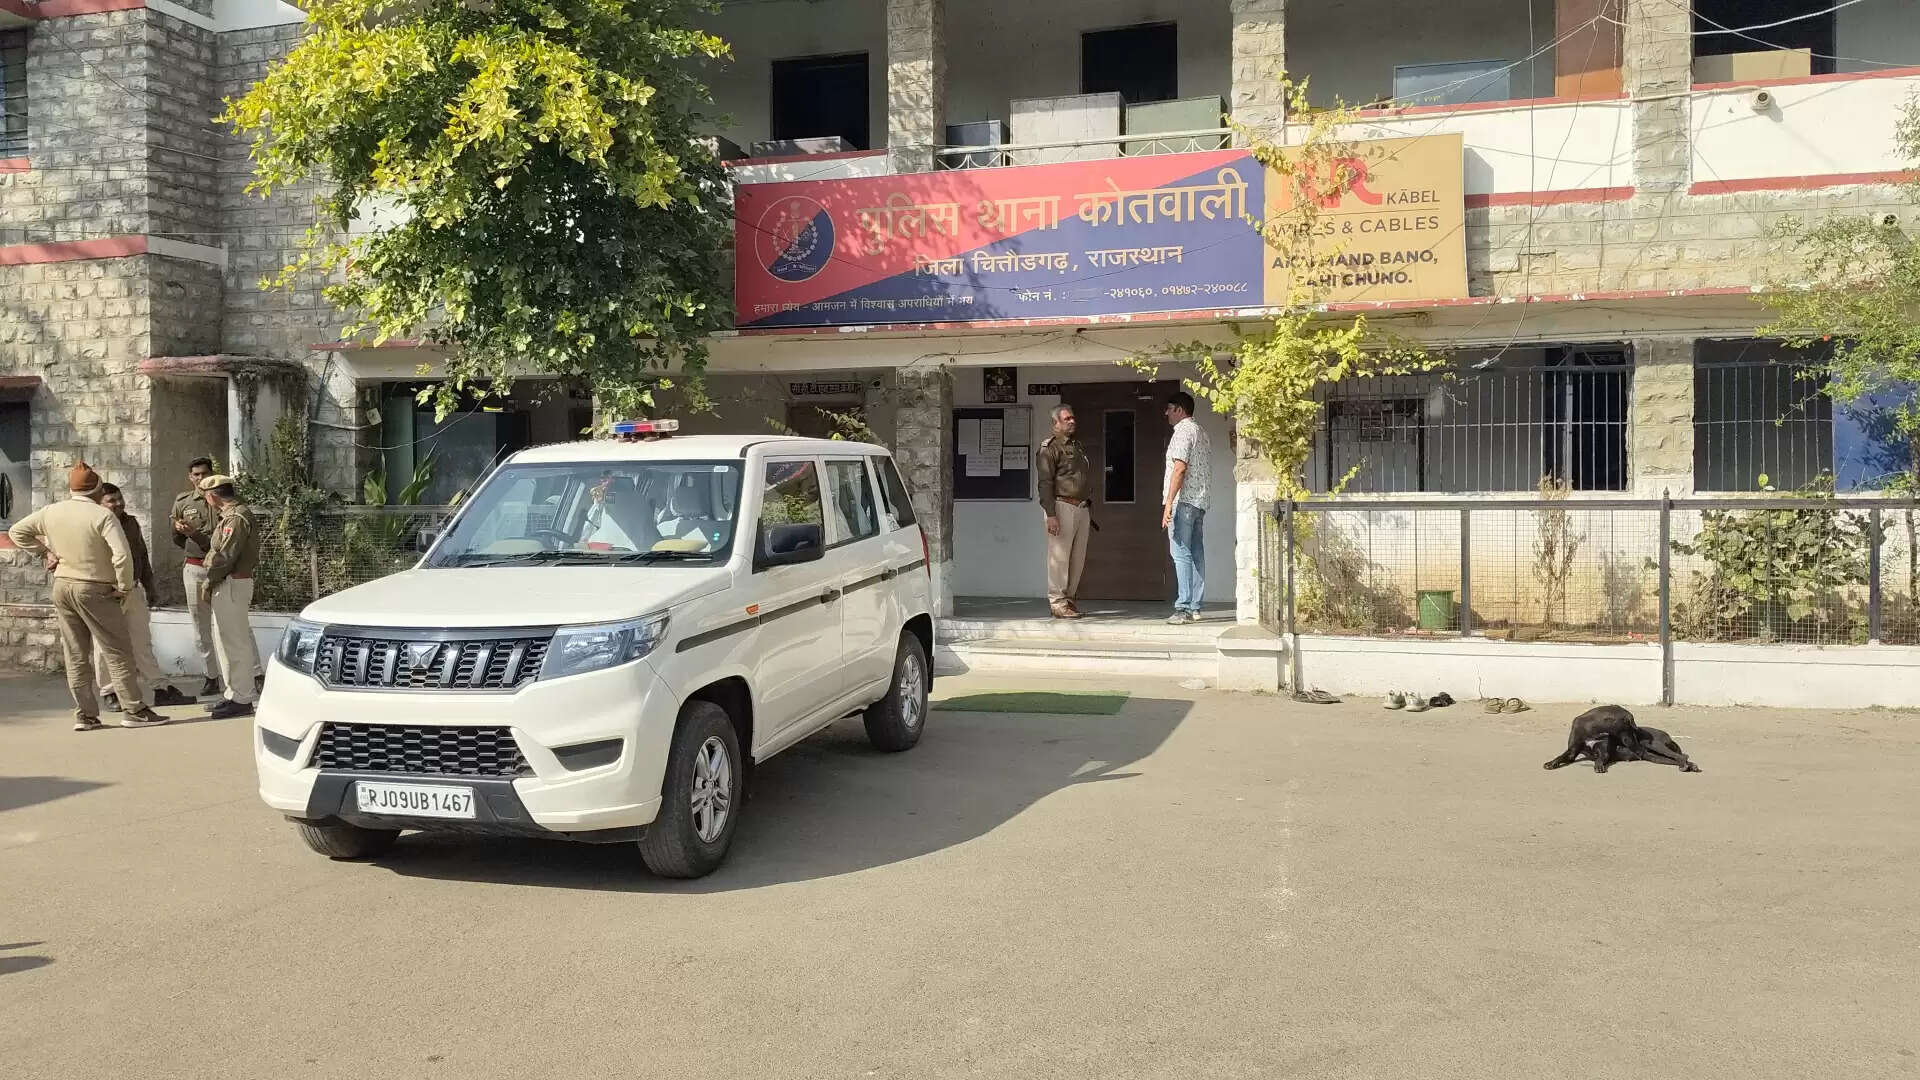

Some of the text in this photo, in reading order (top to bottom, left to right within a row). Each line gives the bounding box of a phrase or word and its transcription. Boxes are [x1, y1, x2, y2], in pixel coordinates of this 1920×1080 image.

[856, 167, 1248, 255] पुलिस थाना कोतवाली
[1341, 220, 1353, 234] &
[1359, 216, 1439, 233] CABLES
[914, 254, 964, 277] जिला
[1085, 245, 1183, 268] राजस्थान
[1380, 249, 1438, 265] BANO,
[1342, 271, 1413, 287] CHUNO.
[753, 303, 779, 313] हमारा
[812, 301, 846, 312] आमजन
[850, 298, 858, 310] में
[861, 297, 894, 310] विश्वास
[899, 295, 943, 308] अपराधियों
[1017, 289, 1040, 302] फोन
[368, 789, 471, 812] RJ09UB1467
